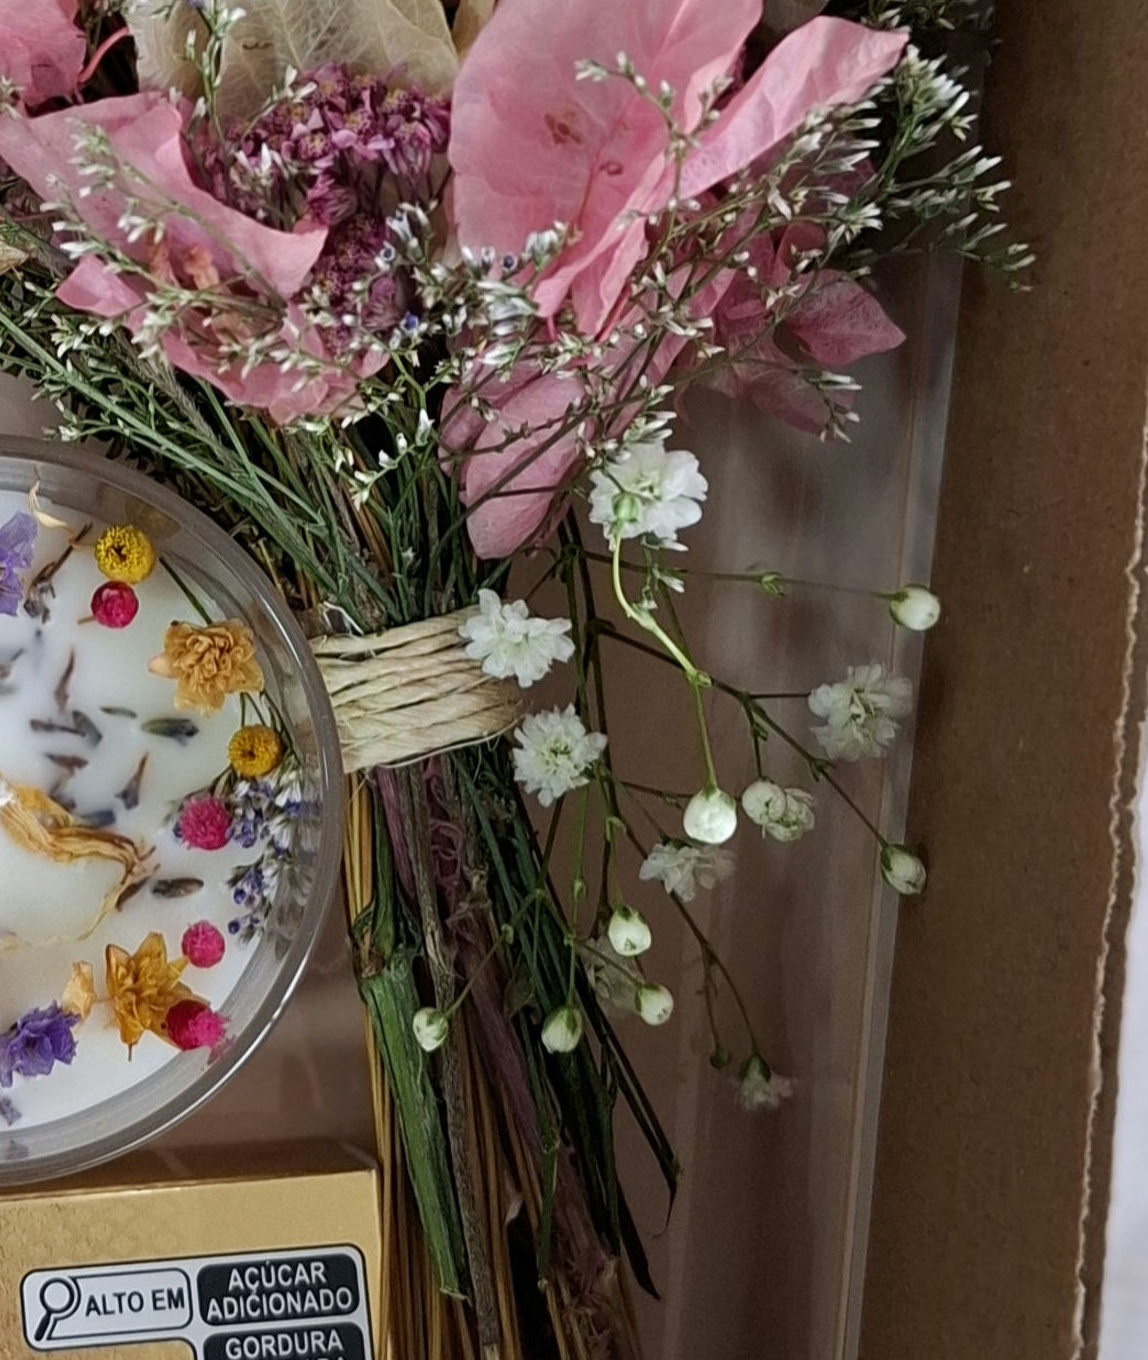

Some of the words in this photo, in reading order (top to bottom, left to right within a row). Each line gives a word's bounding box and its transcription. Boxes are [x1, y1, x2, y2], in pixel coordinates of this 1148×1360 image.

[227, 1260, 327, 1292] AÇÚCAR
[85, 1291, 144, 1317] ALTO
[152, 1287, 185, 1312] EM
[206, 1287, 353, 1323] ADICIONADO
[224, 1329, 343, 1360] GORDURA
